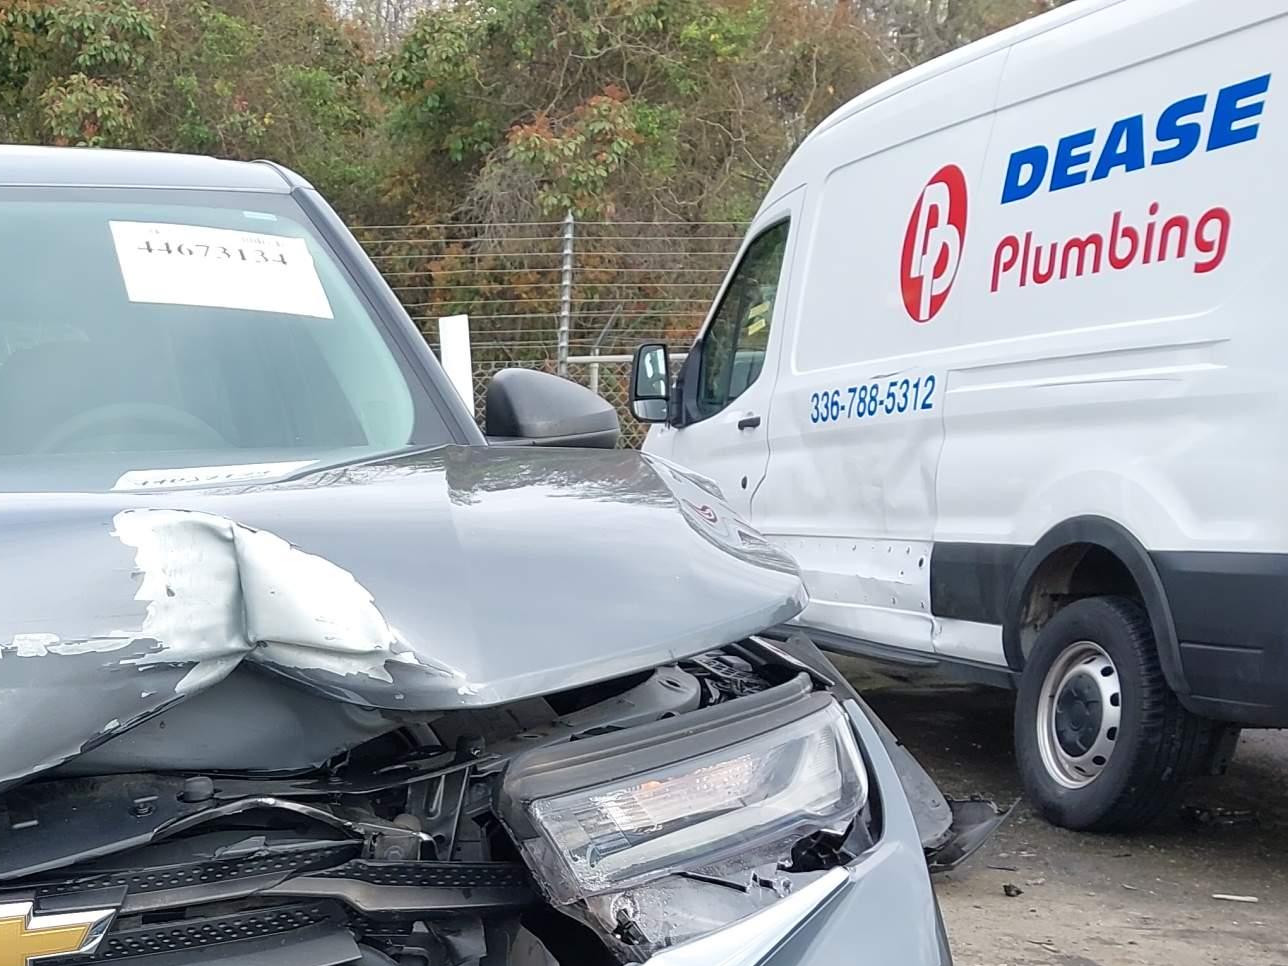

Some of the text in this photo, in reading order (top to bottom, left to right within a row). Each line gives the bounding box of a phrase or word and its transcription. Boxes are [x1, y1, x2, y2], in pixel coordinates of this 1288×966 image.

[1000, 73, 1273, 205] DEASE
[136, 240, 289, 266] 44673134
[991, 202, 1231, 292] Plumbing
[810, 375, 937, 424] 336-788-5312
